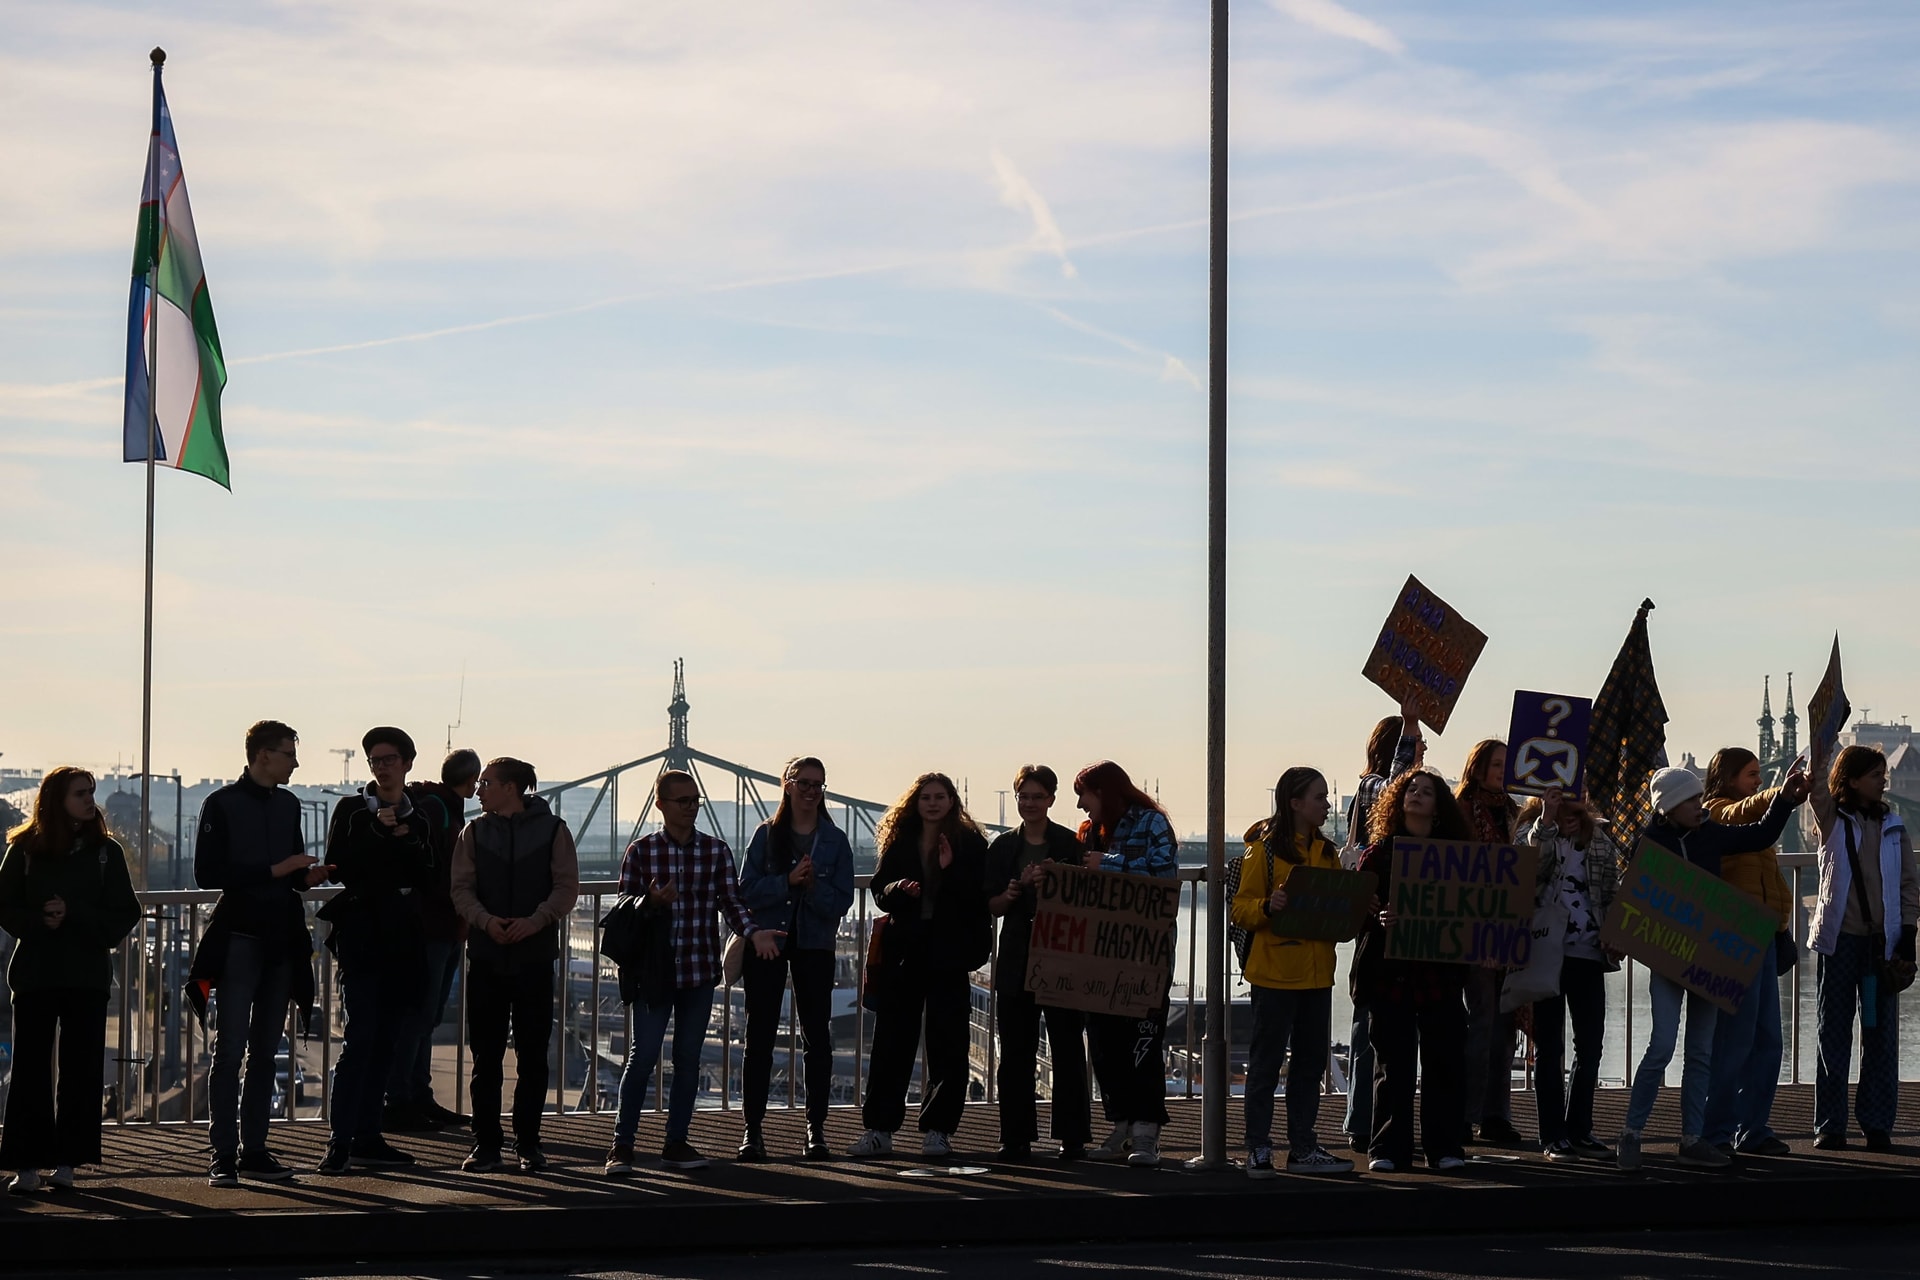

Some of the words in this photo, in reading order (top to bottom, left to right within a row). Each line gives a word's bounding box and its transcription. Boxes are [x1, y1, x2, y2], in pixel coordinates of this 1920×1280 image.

[1404, 587, 1421, 612] A
[1417, 598, 1445, 633] MA
[1379, 630, 1395, 653] A
[1391, 639, 1457, 698] HOLNAP
[1394, 843, 1519, 886] TANÁR
[1638, 845, 1697, 896] NEM
[1041, 870, 1179, 920] DUMBLEDORE
[1397, 880, 1518, 918] NÉLKÜL
[1031, 910, 1088, 954] NEM
[1094, 920, 1173, 966] HAGYNÁ
[1390, 919, 1465, 960] NINCS
[1620, 902, 1698, 962] TANULNI
[1029, 959, 1048, 991] És
[1056, 973, 1074, 991] mi
[1084, 979, 1110, 997] sem
